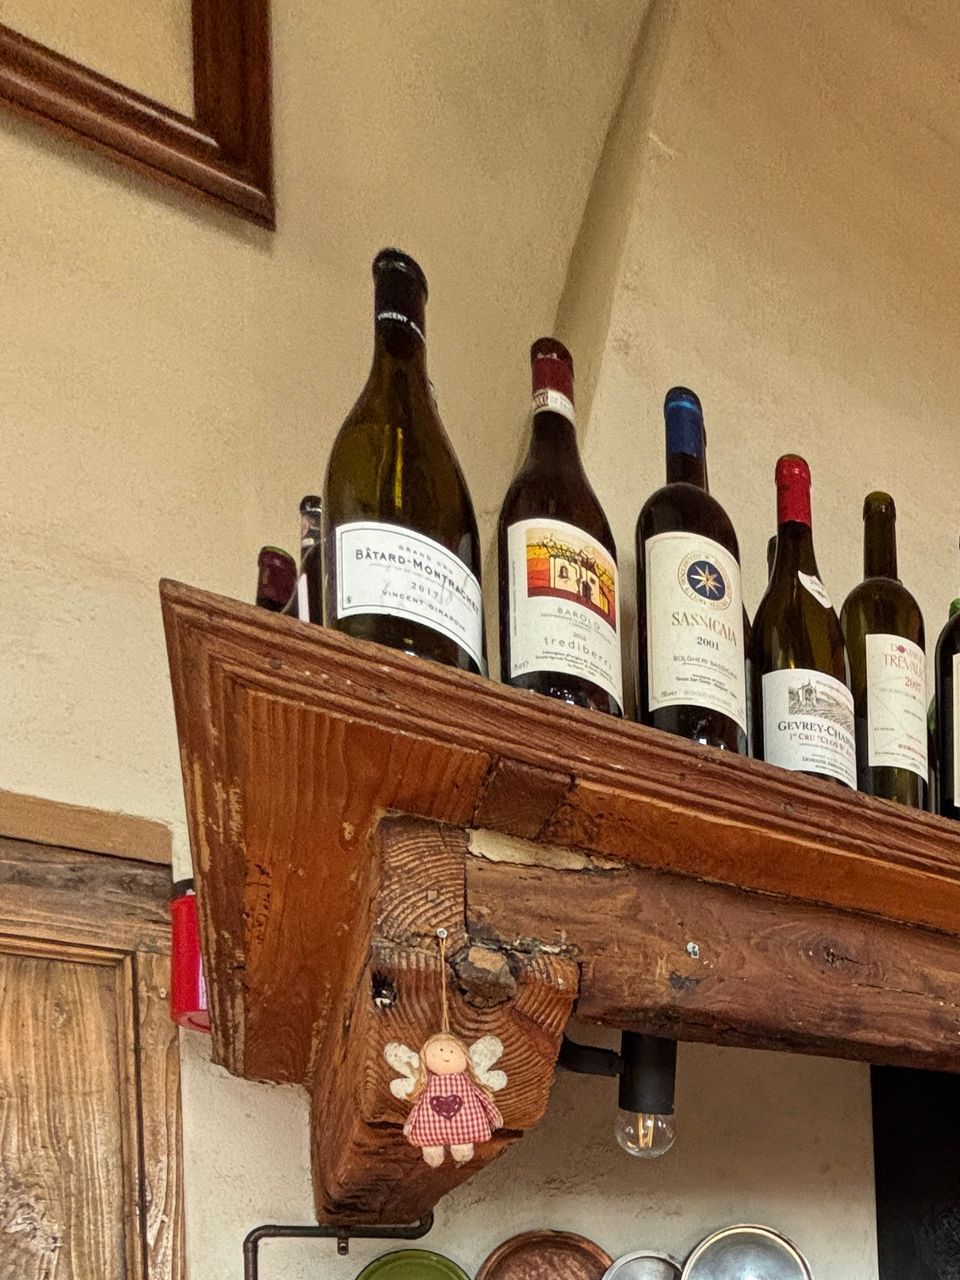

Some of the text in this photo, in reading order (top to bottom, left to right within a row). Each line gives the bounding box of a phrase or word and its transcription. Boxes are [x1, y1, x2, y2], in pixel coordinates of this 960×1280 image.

[382, 589, 424, 606] VINCENT
[411, 581, 439, 599] 2017
[557, 607, 601, 631] BAROLO
[671, 611, 737, 647] SASSICAIA
[697, 636, 719, 651] 2001
